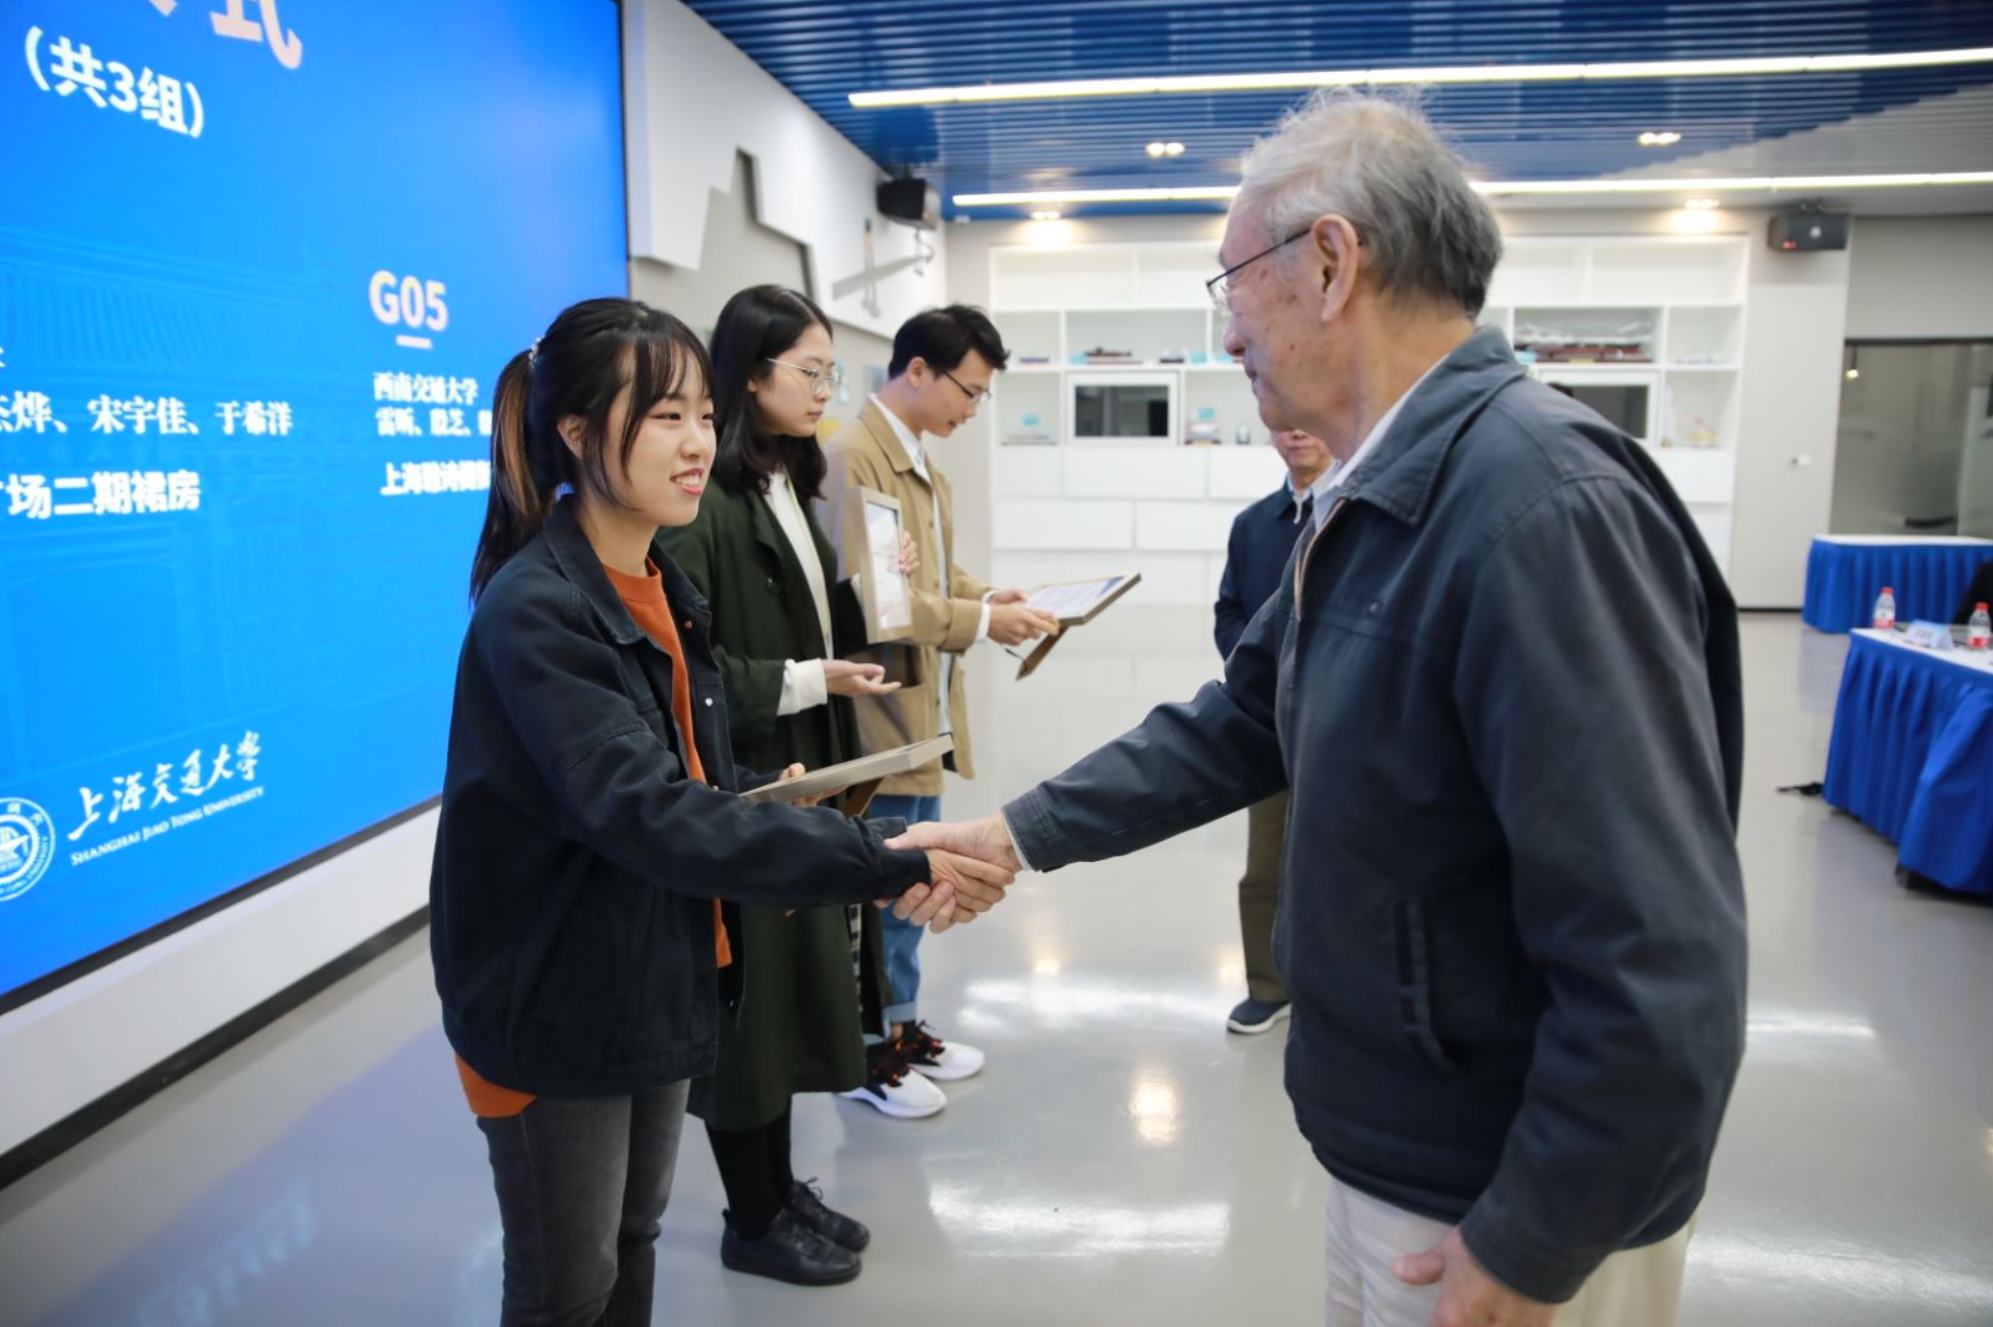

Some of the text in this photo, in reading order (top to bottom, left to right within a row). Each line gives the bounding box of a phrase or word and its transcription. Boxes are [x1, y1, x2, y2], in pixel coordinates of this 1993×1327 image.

[25, 25, 204, 138] (共3组)
[369, 270, 448, 331] G05
[373, 371, 478, 405] 西南交通大学
[0, 468, 201, 519] 场二期裙房
[70, 831, 141, 866] SHANGHAI
[142, 820, 170, 842] JIAO
[170, 807, 204, 829] TONG
[203, 786, 264, 816] UNIVERSITY
